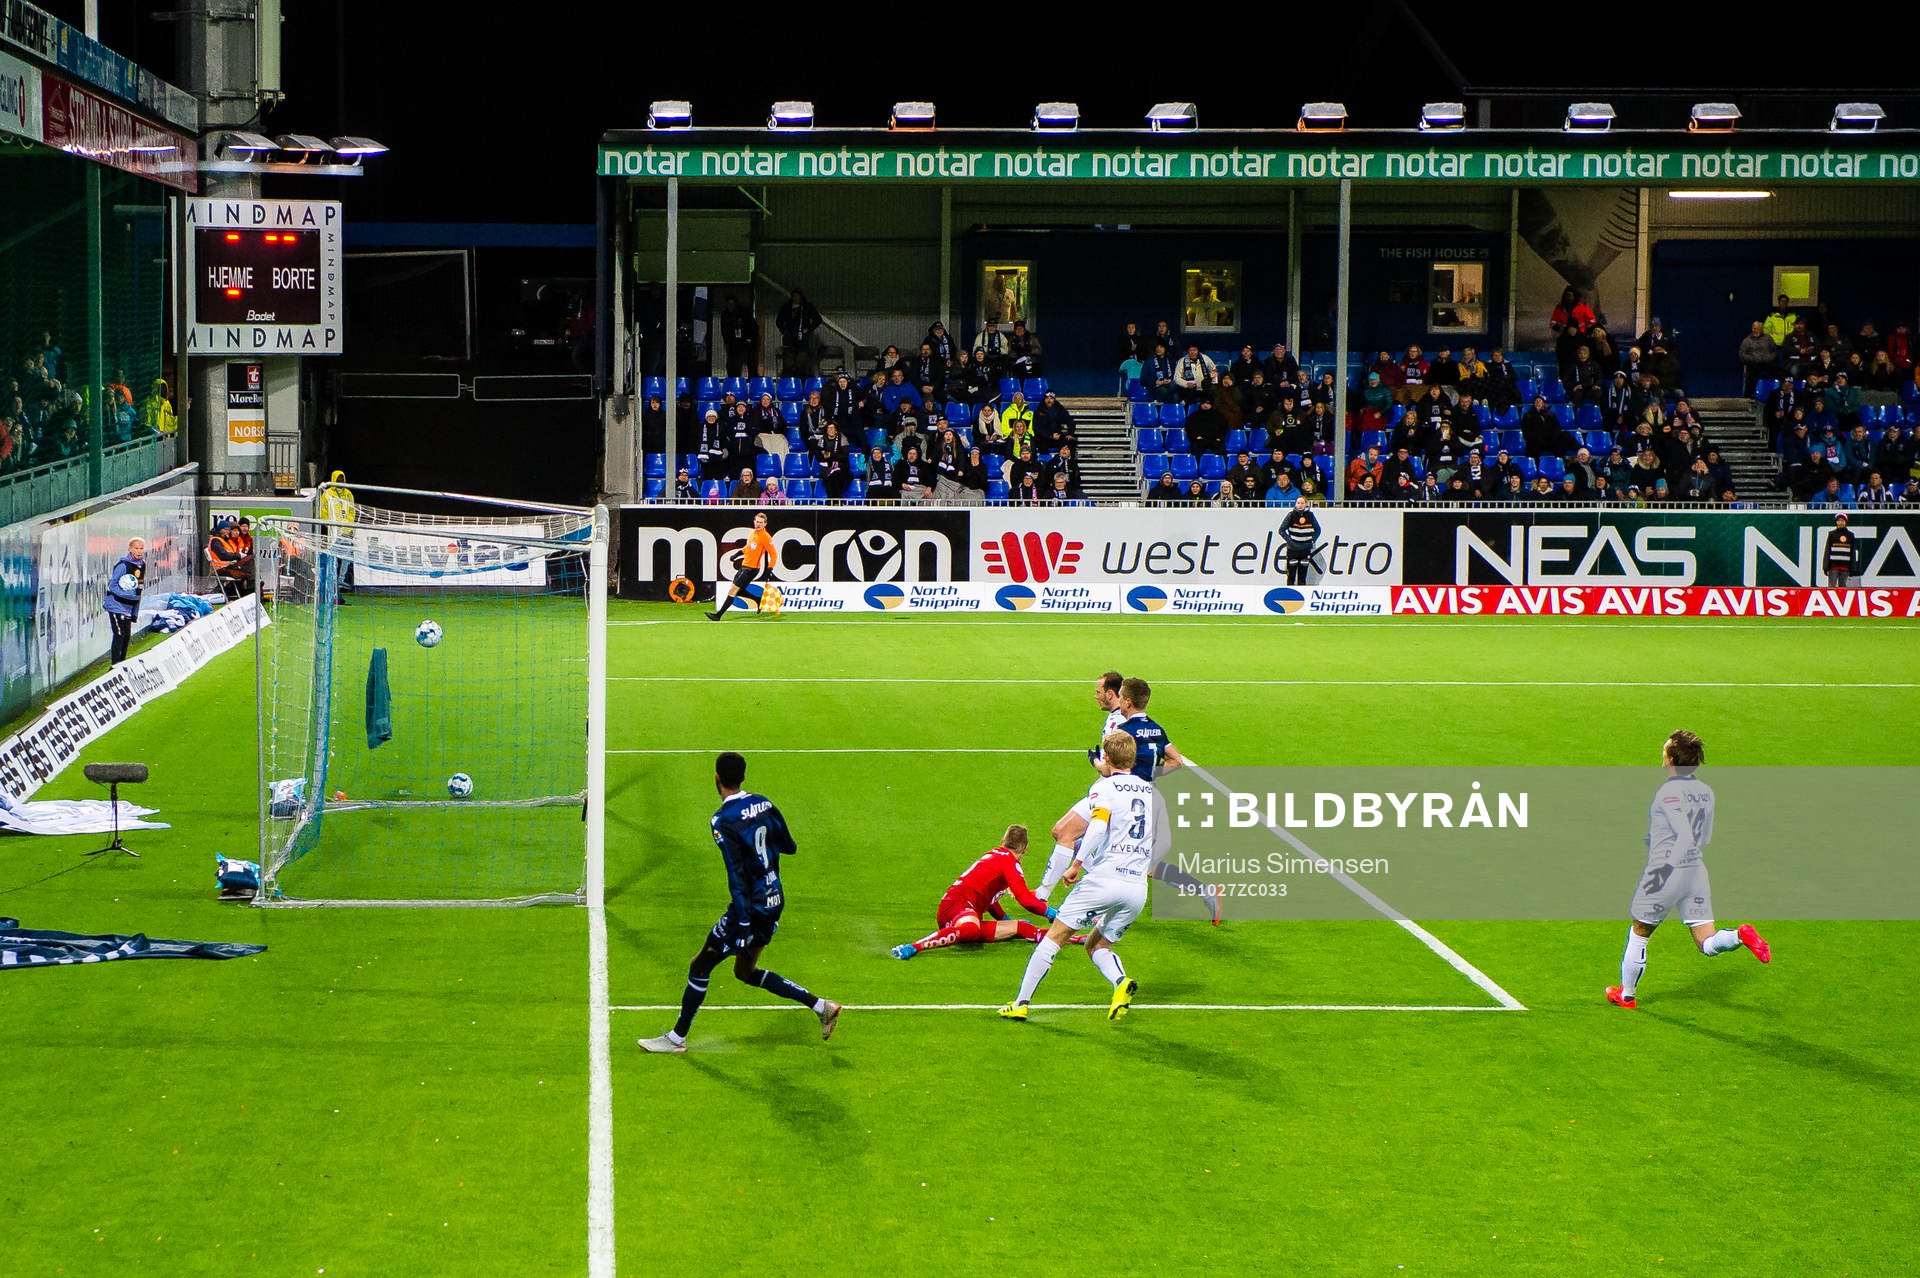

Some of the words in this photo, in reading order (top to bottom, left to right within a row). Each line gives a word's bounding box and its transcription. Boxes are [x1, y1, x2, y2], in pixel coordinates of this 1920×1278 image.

[604, 147, 689, 175] notar
[702, 147, 788, 175] notar
[799, 147, 884, 175] notar
[896, 148, 982, 176] notar
[994, 148, 1080, 176] notar
[1092, 148, 1178, 176] notar
[1190, 148, 1276, 176] notar
[1288, 149, 1374, 176] notar
[1387, 149, 1472, 177] notar
[1484, 149, 1570, 177] notar
[1583, 149, 1669, 177] notar
[1682, 149, 1768, 177] notar
[1780, 149, 1866, 177] notar
[1380, 247, 1402, 259] THE
[1406, 247, 1431, 259] FISH
[1435, 247, 1476, 259] HOUSE
[208, 266, 253, 289] HJEMME
[273, 267, 315, 290] BORTE
[327, 233, 335, 321] MINDMAP
[246, 309, 276, 321] Bodet
[638, 526, 952, 582] macron
[1102, 534, 1220, 575] west
[1231, 530, 1393, 576] elektro
[1455, 524, 1697, 587] NEAS
[777, 585, 822, 596] North
[910, 585, 958, 596] North
[1042, 586, 1090, 597] North
[1174, 588, 1221, 599] North
[1311, 589, 1359, 600] North
[783, 598, 844, 610] hipping
[909, 597, 981, 610] Shipping
[1041, 598, 1112, 611] Shipping
[1172, 599, 1244, 613] Shipping
[1310, 601, 1381, 614] Shipping
[10, 735, 53, 784] TESS
[38, 717, 75, 765] TESS
[78, 679, 116, 729] TESS
[103, 674, 137, 712] TESS
[1148, 742, 1157, 777] 7
[1128, 798, 1146, 840] 3
[754, 825, 769, 870] 9
